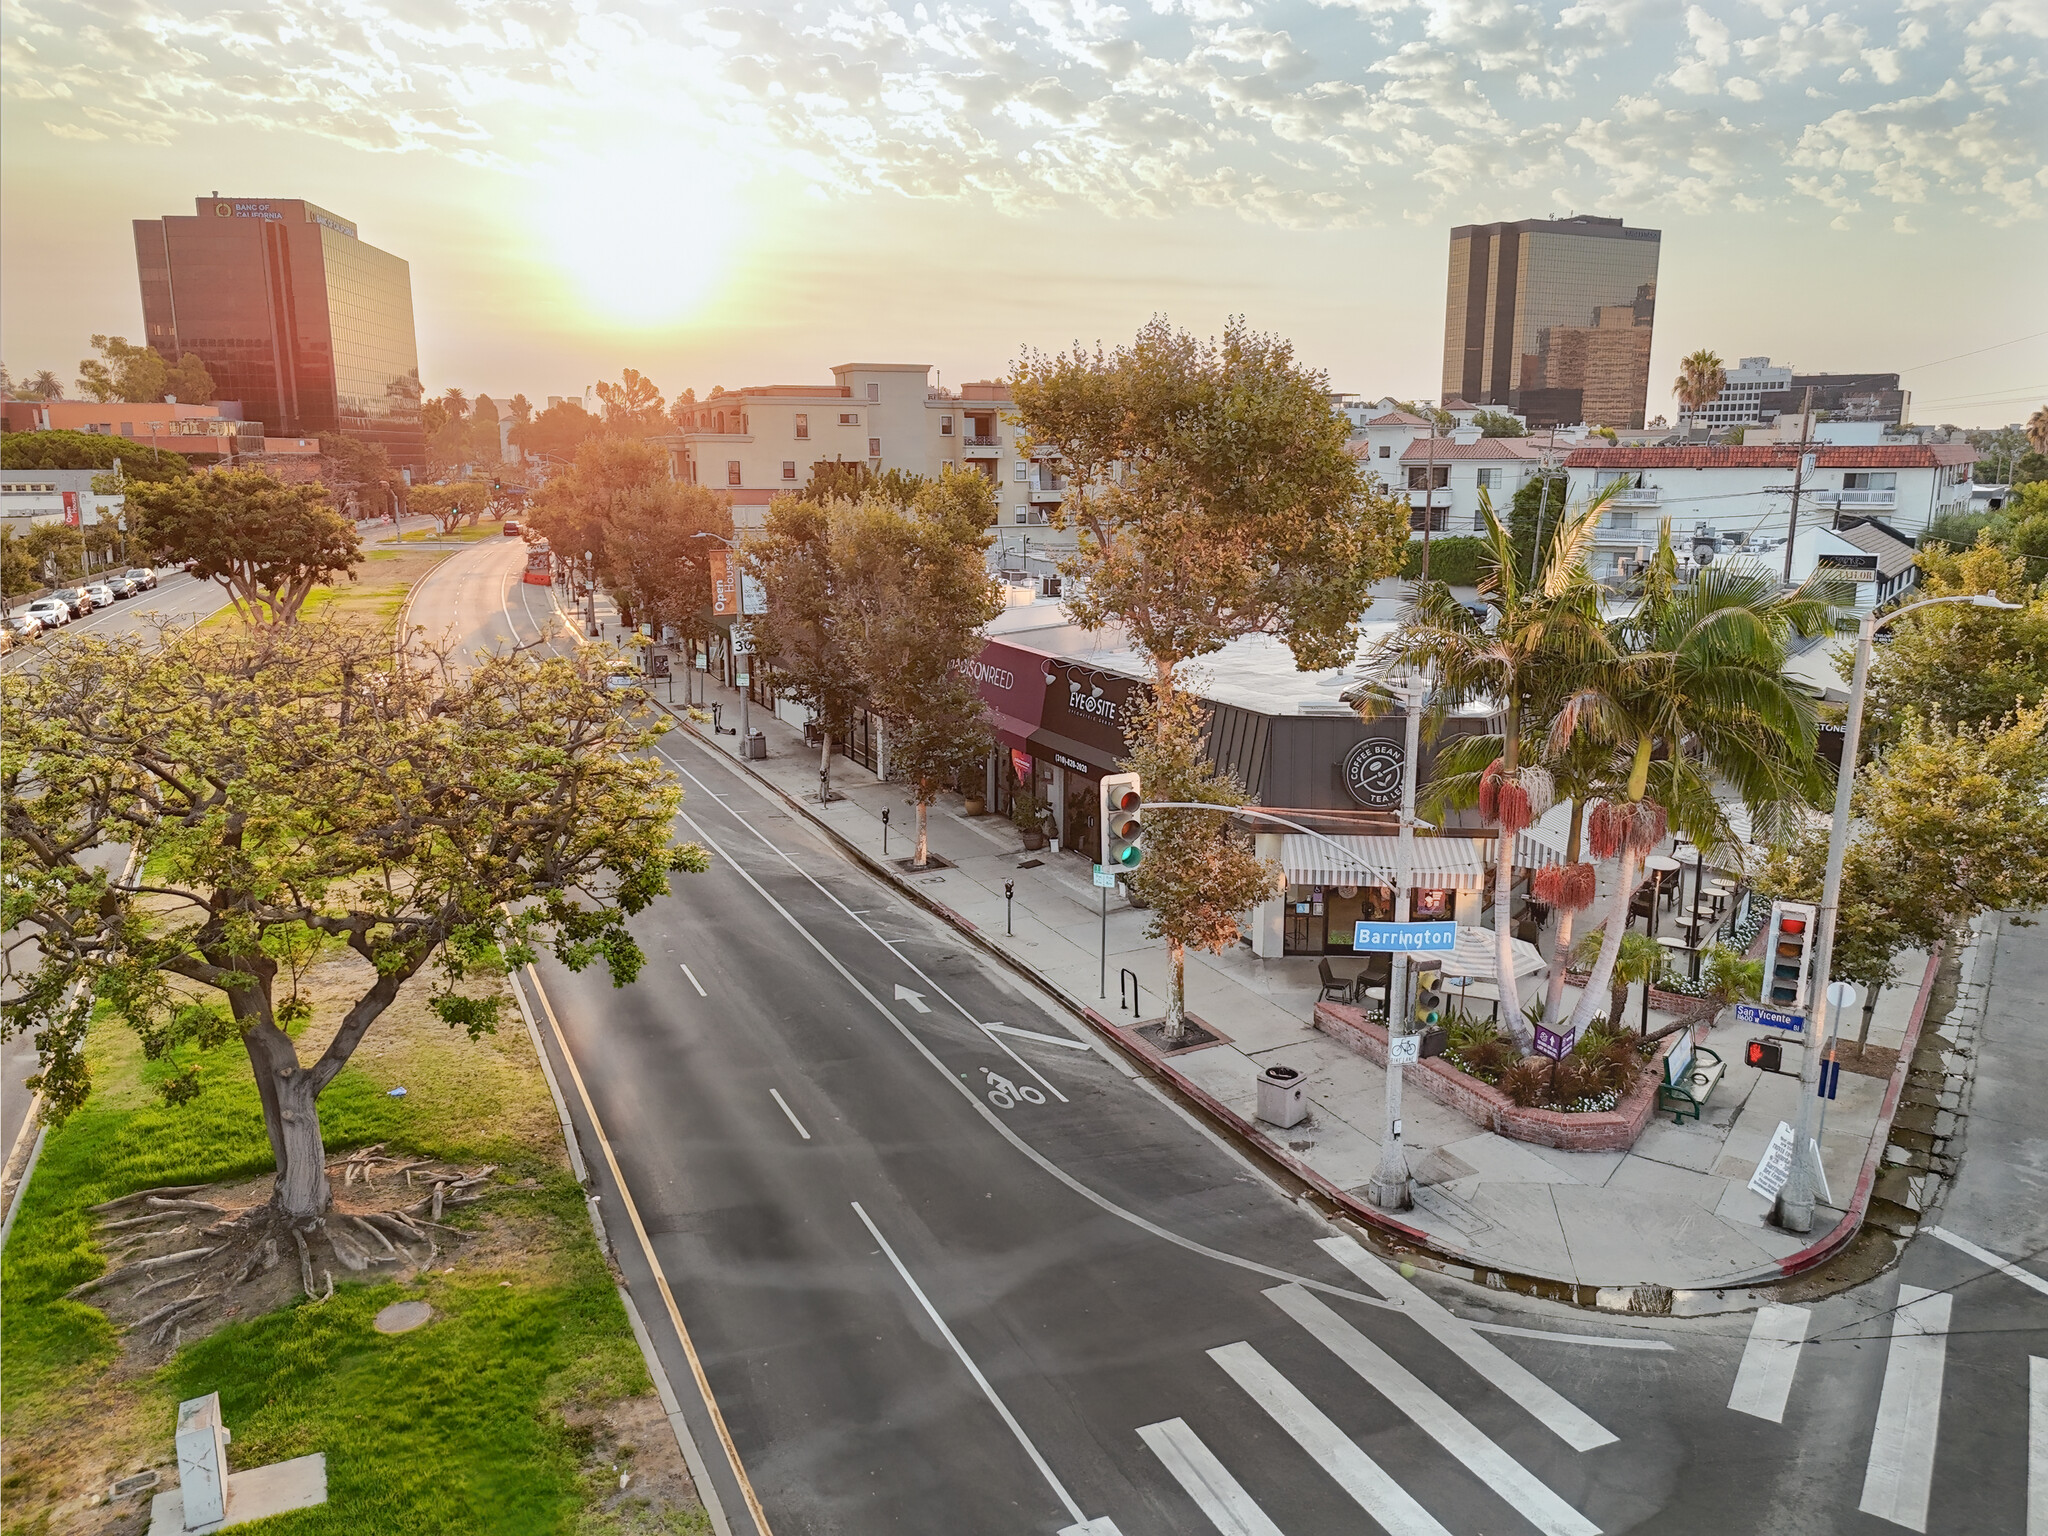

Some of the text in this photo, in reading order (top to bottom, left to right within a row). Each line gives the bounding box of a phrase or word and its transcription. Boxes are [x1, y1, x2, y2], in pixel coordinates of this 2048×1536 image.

[235, 203, 257, 211] BANC
[724, 553, 735, 592] Houses
[714, 580, 727, 611] Open
[735, 641, 752, 652] 30
[1351, 746, 1401, 780] COFFEE BEAN
[1370, 794, 1389, 803] TEA
[1358, 928, 1452, 949] Barrington
[1737, 1005, 1791, 1024] San Vicente
[1402, 1055, 1414, 1064] LANE
